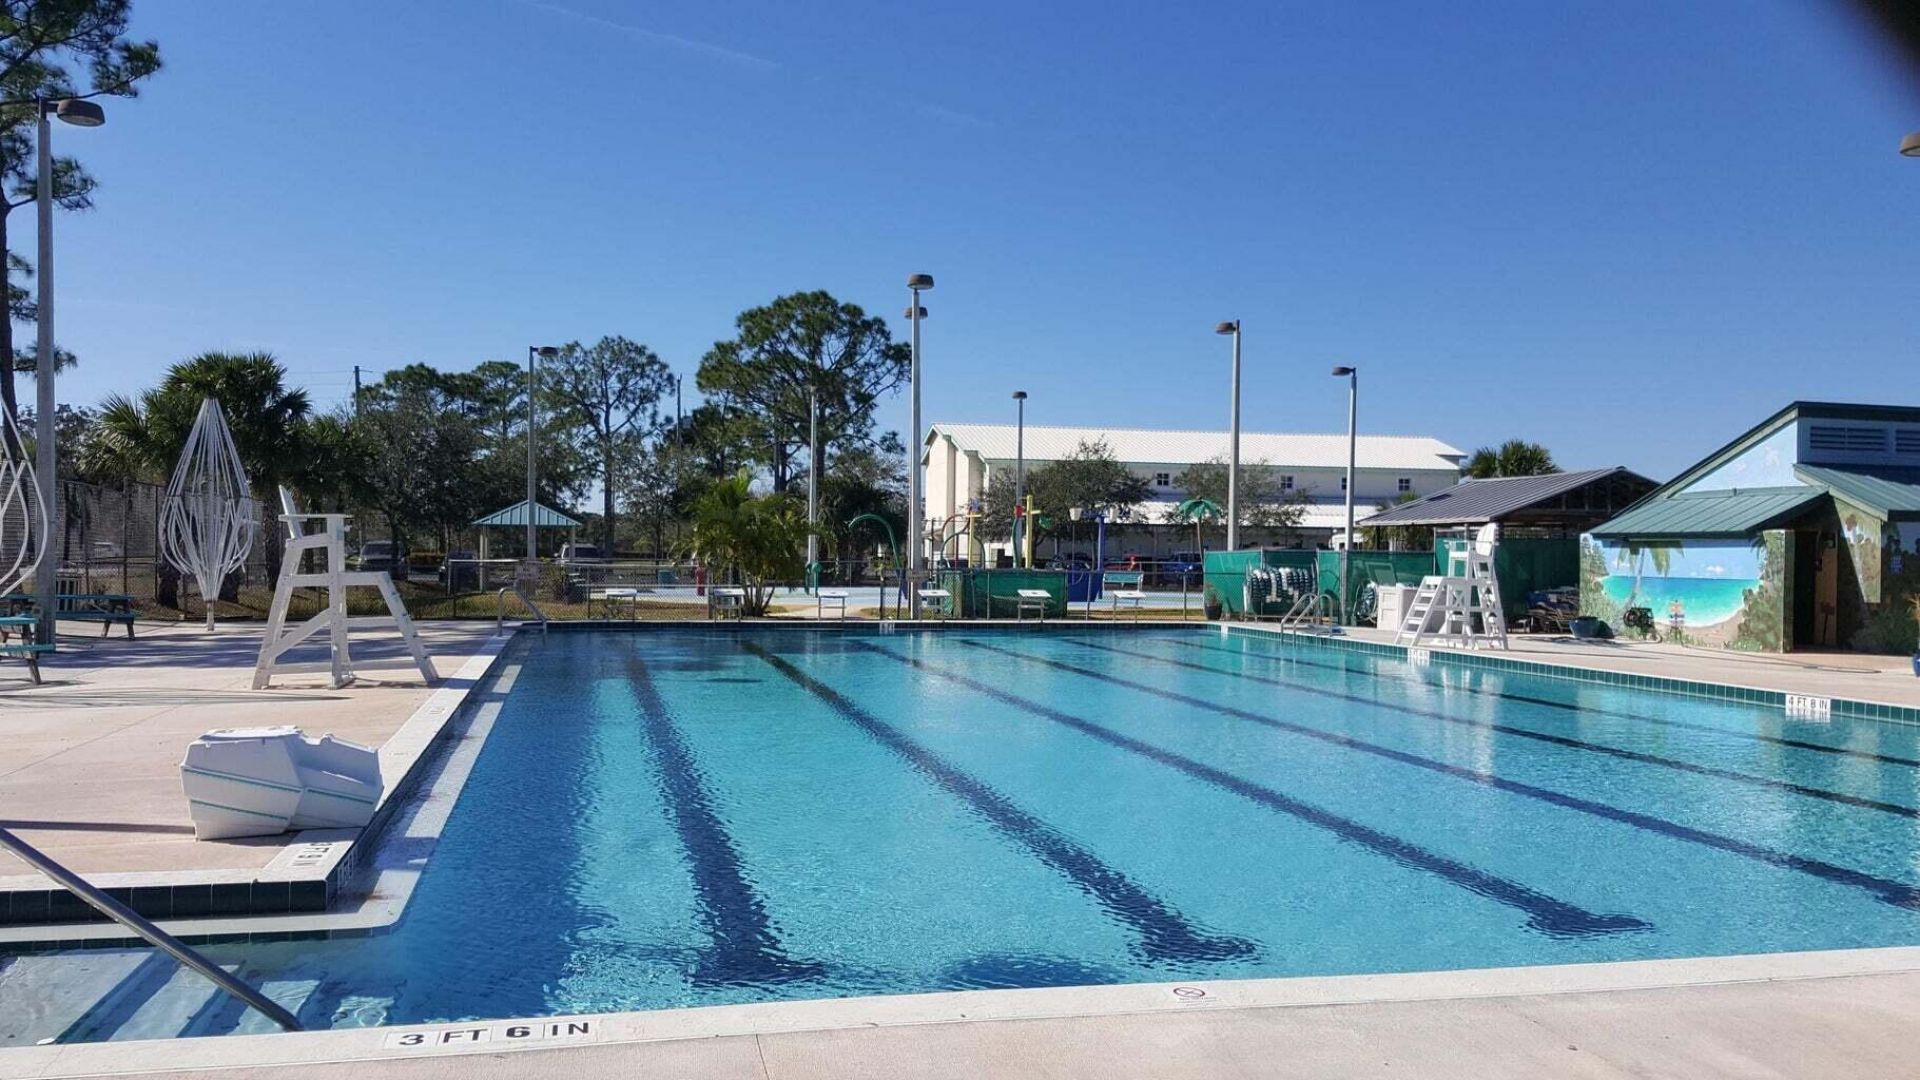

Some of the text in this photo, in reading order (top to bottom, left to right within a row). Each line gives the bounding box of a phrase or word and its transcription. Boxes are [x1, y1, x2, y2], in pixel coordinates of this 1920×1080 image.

[1797, 696, 1806, 707] FT
[1820, 699, 1827, 710] IN
[399, 1022, 589, 1046] 3 FT 6 IN
